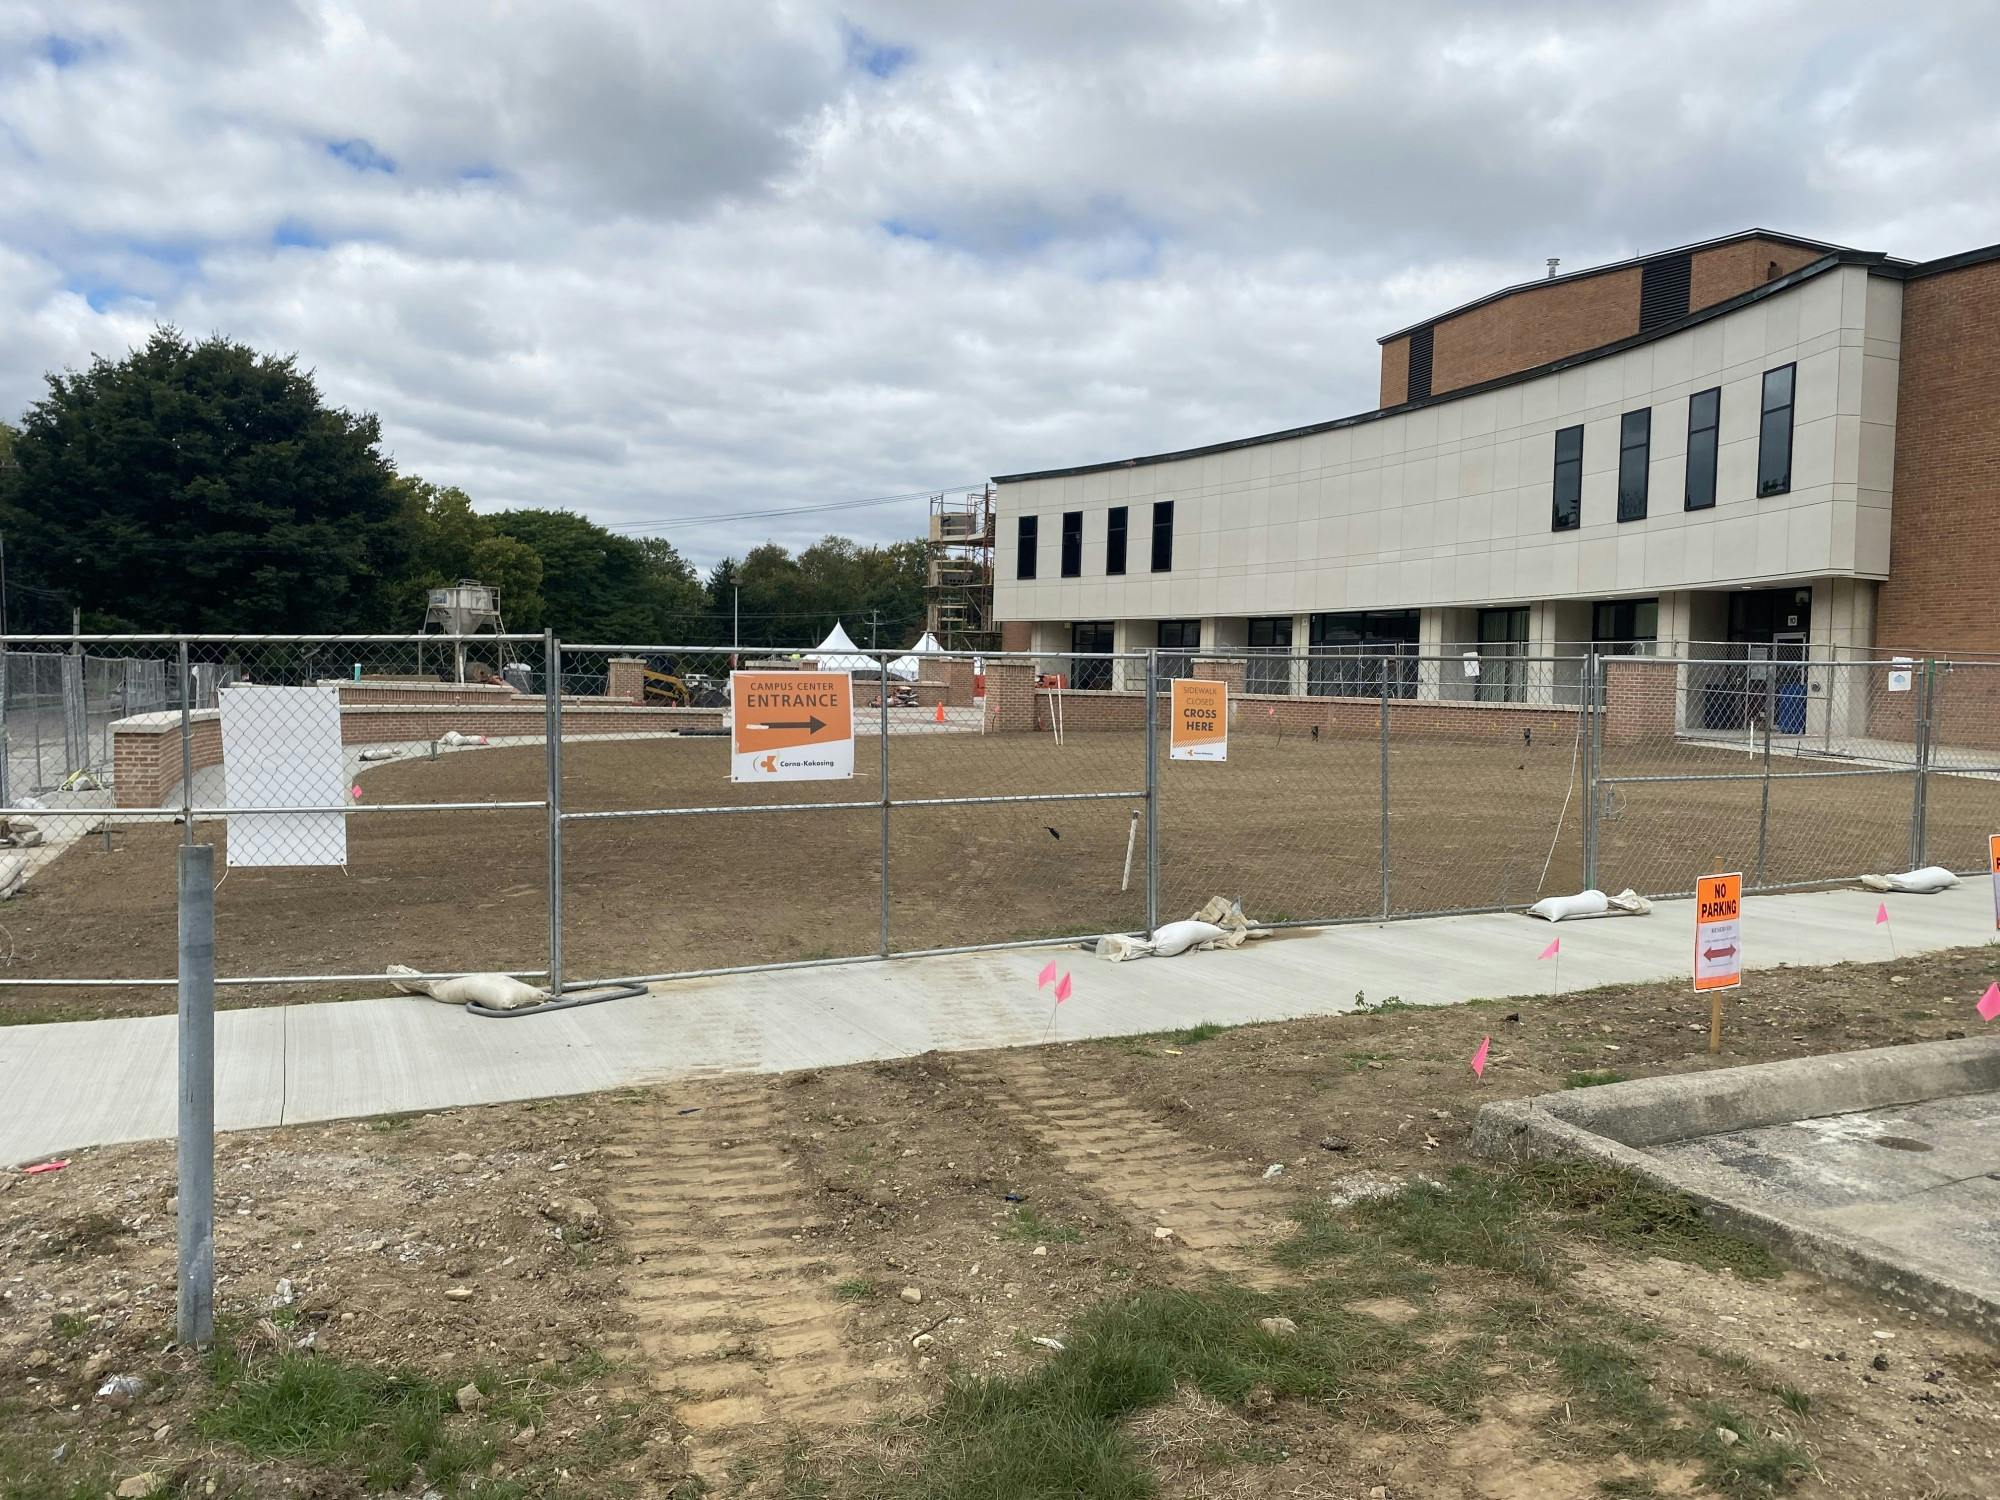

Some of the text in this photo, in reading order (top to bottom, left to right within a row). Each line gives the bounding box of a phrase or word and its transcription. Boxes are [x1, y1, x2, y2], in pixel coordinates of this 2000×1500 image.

[750, 682, 834, 691] CAMPUS CENTER
[1183, 686, 1217, 695] SIDEWALK
[747, 694, 838, 708] ENTRANCE
[1186, 697, 1215, 706] CLOSED
[1183, 708, 1217, 719] CROSS
[1186, 721, 1214, 732] HERE
[780, 759, 835, 768] Corna-Kokosing
[1714, 883, 1727, 899] NO
[1701, 900, 1737, 918] PARKING
